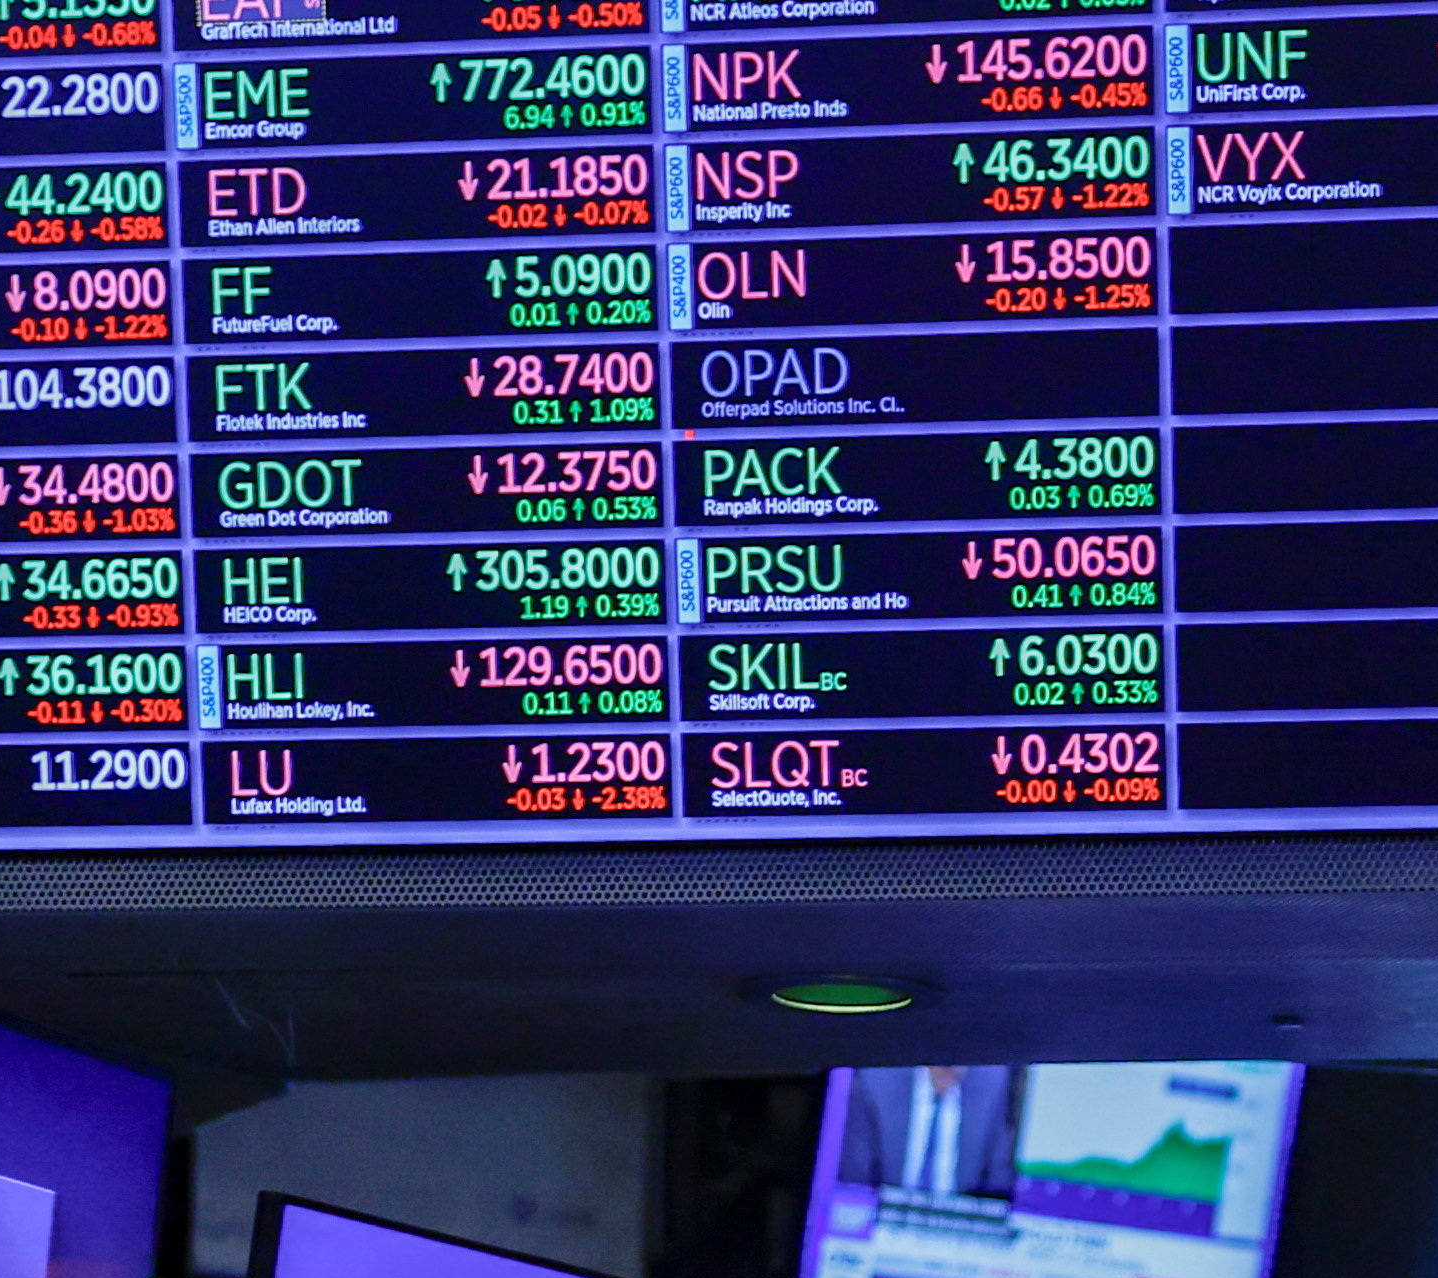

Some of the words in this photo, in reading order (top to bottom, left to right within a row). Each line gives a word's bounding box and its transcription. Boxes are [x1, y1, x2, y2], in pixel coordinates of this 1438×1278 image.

[692, 48, 802, 103] NPK
[956, 33, 1148, 84] 145.6200
[1196, 29, 1309, 84] UNF
[1, 71, 159, 118] 22.2800
[203, 67, 312, 121] EME
[459, 52, 647, 103] 772.4600
[204, 121, 255, 140] Emcor
[255, 119, 305, 140] Group
[503, 103, 556, 131] 6.94
[579, 100, 646, 128] 0.91%
[695, 149, 799, 202] NSP
[982, 134, 1151, 183] 46.3400
[1196, 130, 1306, 183] VYX
[4, 169, 164, 217] 44.2400
[207, 166, 307, 218] ETD
[486, 153, 649, 201] 21.1850
[32, 267, 167, 312] 8.0900
[211, 265, 273, 316] FF
[514, 251, 652, 298] 5.0900
[697, 248, 807, 301] OLN
[986, 235, 1152, 283] 15.8500
[212, 314, 294, 335] FutureFuel
[697, 301, 731, 320] Olin
[215, 361, 313, 413] FTK
[492, 351, 654, 397] 28.7400
[701, 347, 848, 398] OPAD
[17, 461, 175, 506] 34.4800
[218, 458, 362, 510] GDOT
[496, 448, 657, 495] 12.3750
[703, 446, 843, 498] PACK
[1013, 435, 1155, 481] 4.3800
[703, 497, 763, 519] Ranpak
[764, 496, 833, 517] Holdings
[835, 495, 879, 516] Corp.
[21, 556, 179, 602] 34.6650
[222, 556, 303, 606] HEI
[475, 546, 660, 592] 305.8000
[706, 544, 843, 595] PRSU
[991, 534, 1157, 580] 50.0650
[25, 652, 183, 696] 36.1600
[226, 652, 305, 701] HLI
[478, 642, 664, 688] 129.6500
[708, 642, 824, 692] SKIL
[1018, 632, 1158, 677] 6.0300
[522, 691, 575, 716] 0.11
[597, 688, 663, 715] 0.08%
[31, 748, 186, 791] 11.2900
[230, 749, 293, 797] LU
[531, 740, 666, 784] 1.2300
[711, 739, 840, 790] SLQT
[1020, 731, 1160, 776] 0.4302
